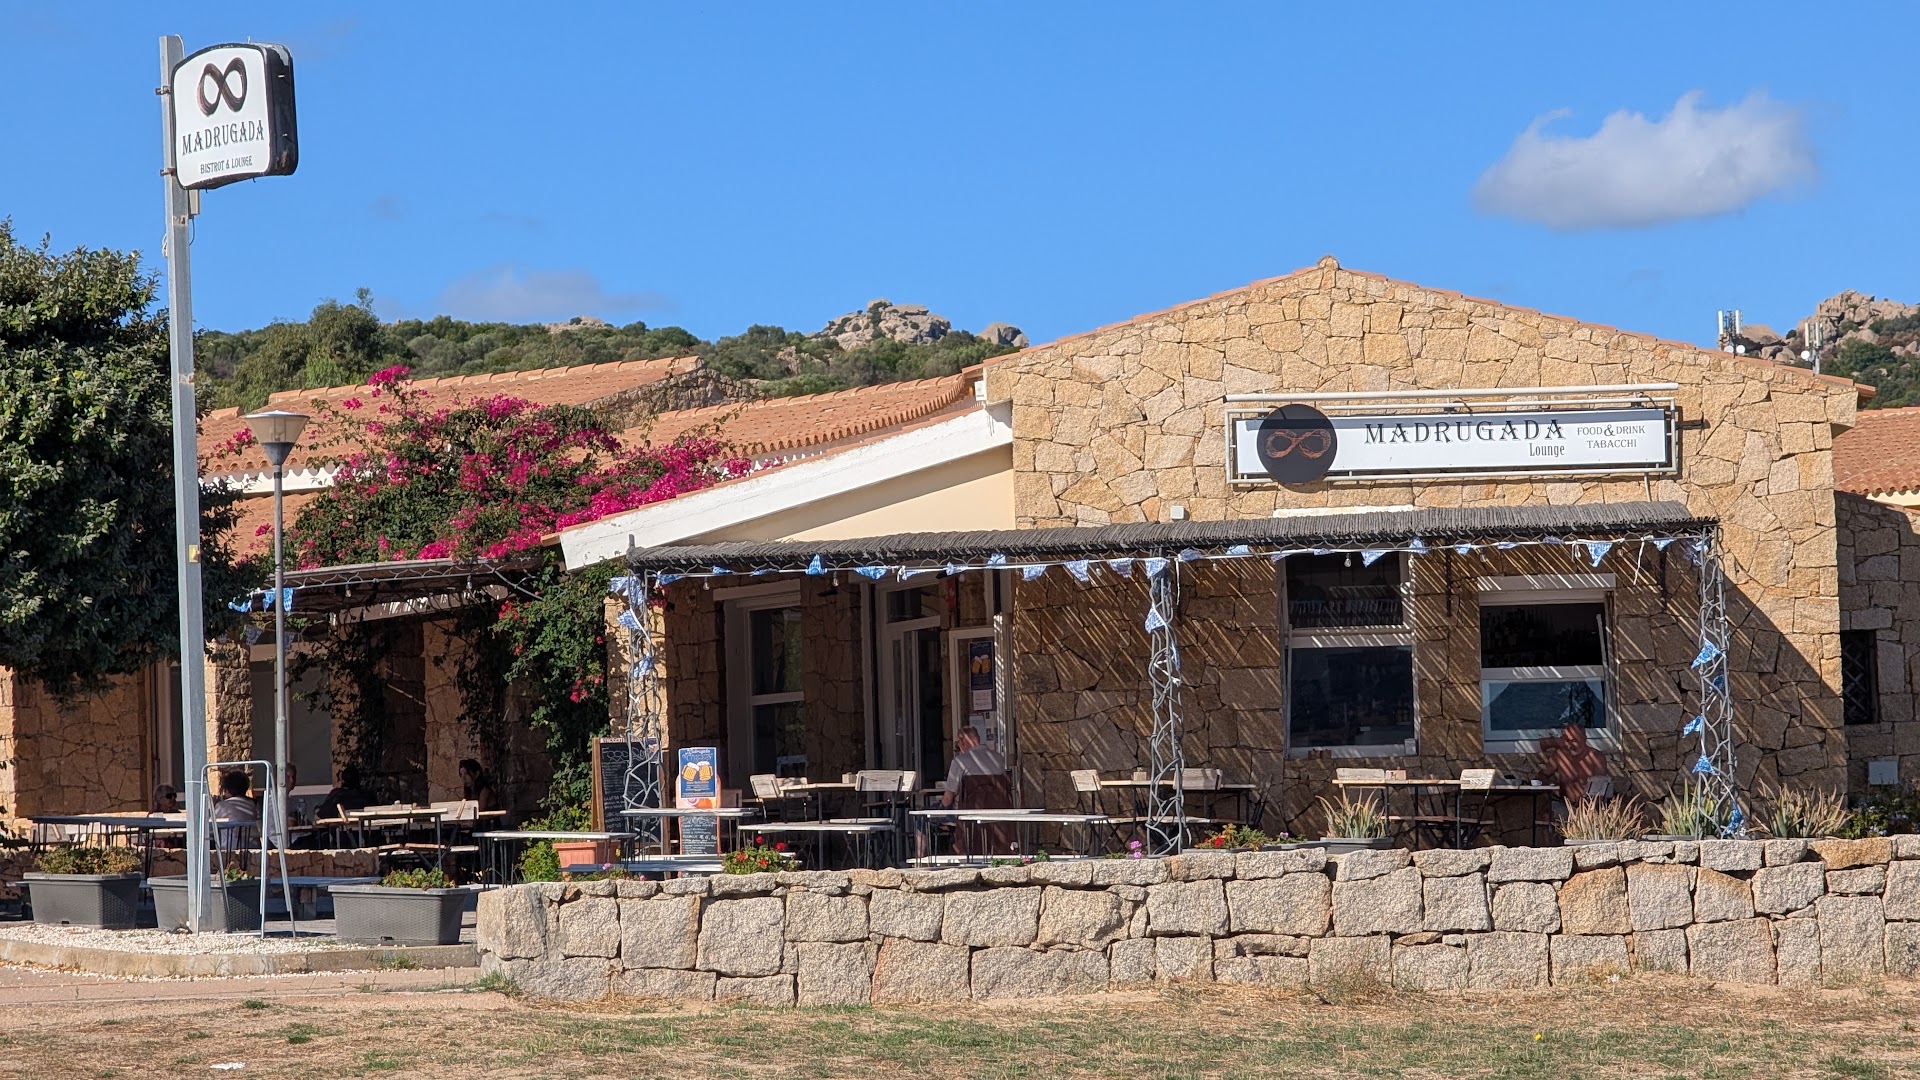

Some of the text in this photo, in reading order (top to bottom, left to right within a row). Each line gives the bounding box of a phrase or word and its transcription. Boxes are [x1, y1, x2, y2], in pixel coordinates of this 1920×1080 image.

[182, 120, 264, 156] MADRUGADA
[200, 155, 253, 174] BISTROT & LOUNGE
[1364, 419, 1567, 445] MADRUGADA
[1528, 443, 1565, 458] Lounge
[1586, 439, 1638, 449] TABACCHI
